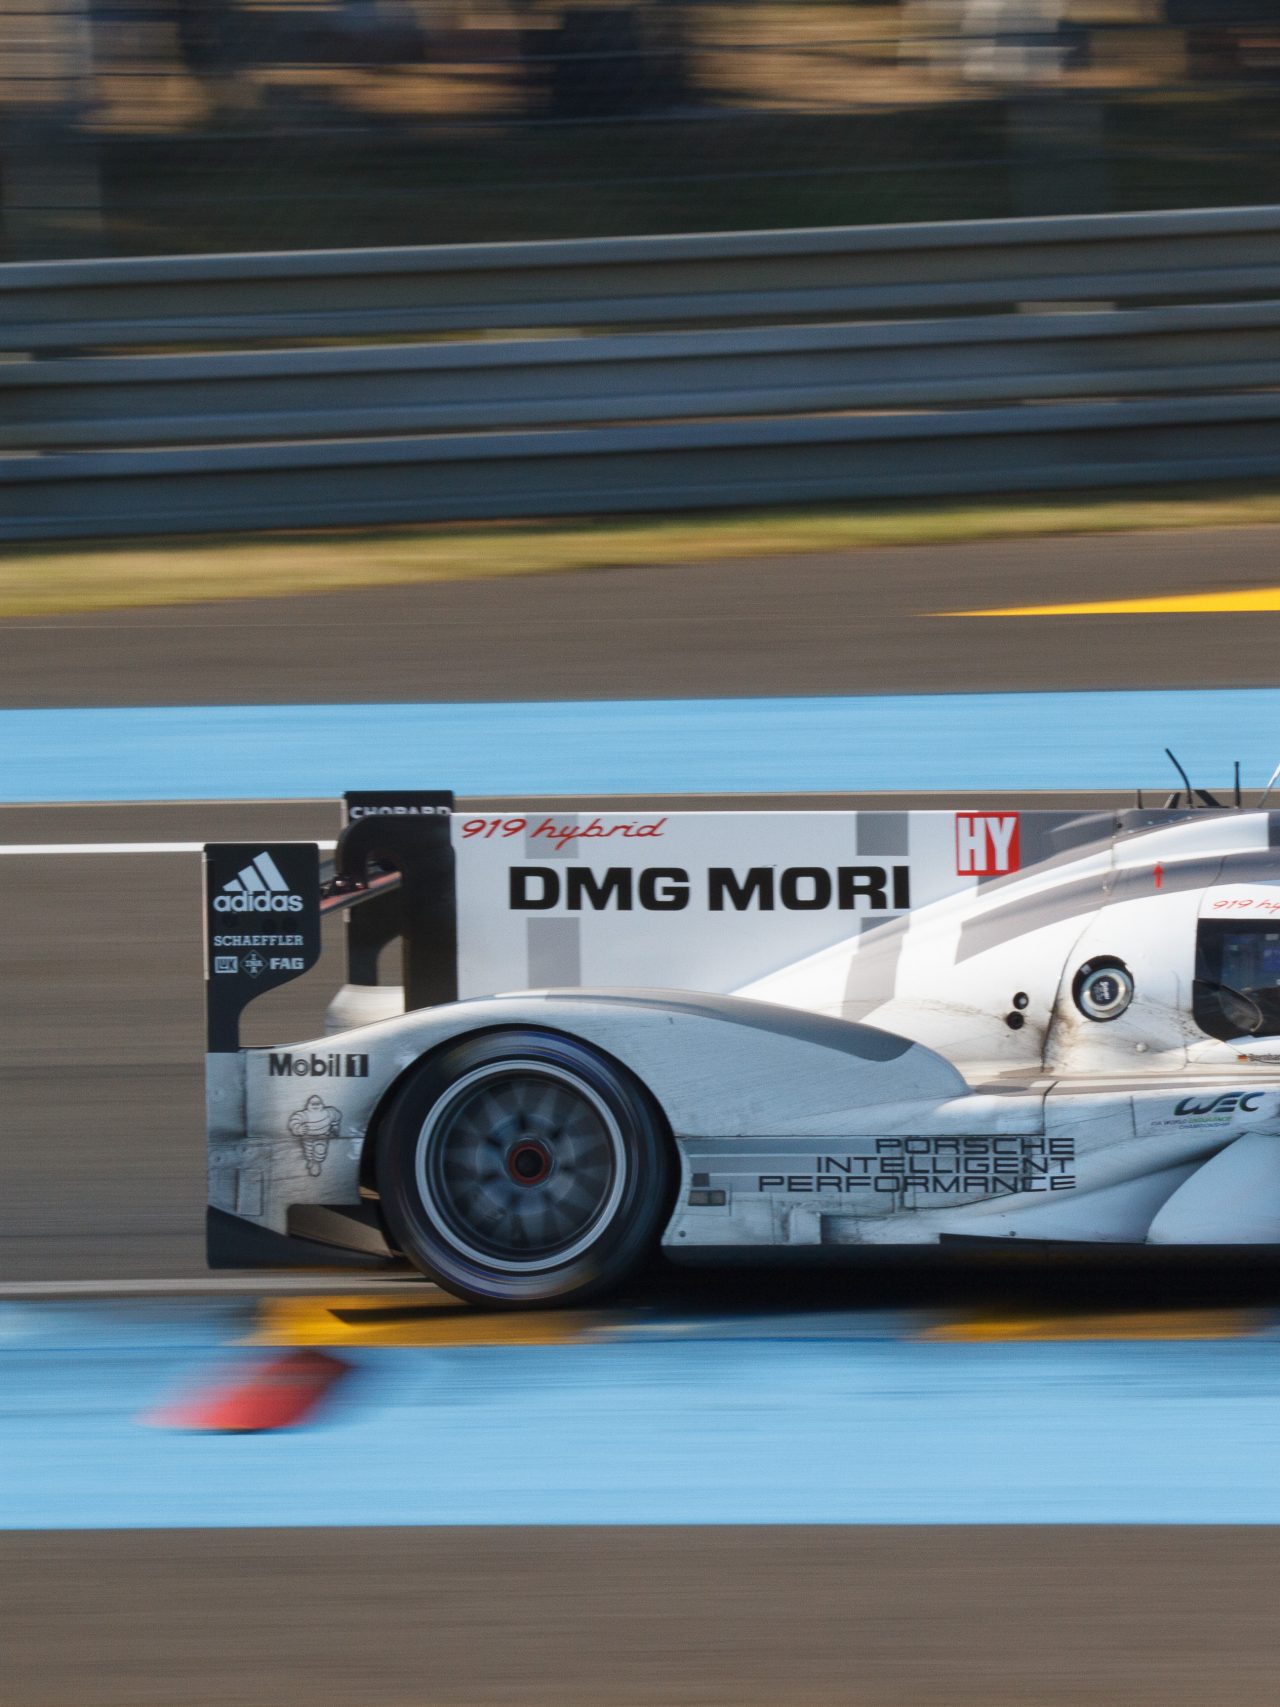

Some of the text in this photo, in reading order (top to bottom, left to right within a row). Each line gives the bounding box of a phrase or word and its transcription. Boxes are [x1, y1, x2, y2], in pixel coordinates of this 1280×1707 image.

[462, 818, 668, 850] 919 hybrid
[958, 816, 1017, 871] HY
[508, 866, 910, 911] DMG MORI
[213, 890, 303, 912] adidas
[1213, 899, 1253, 910] 919
[213, 935, 304, 946] SCHAEFFLER
[270, 957, 304, 970] FAG
[268, 1053, 369, 1077] Mobil 1
[1173, 1091, 1266, 1116] WEC
[875, 1137, 1075, 1155] PORSCHE
[816, 1156, 1075, 1174] INTELLIGENT
[757, 1175, 1077, 1192] PERFORMANCE
